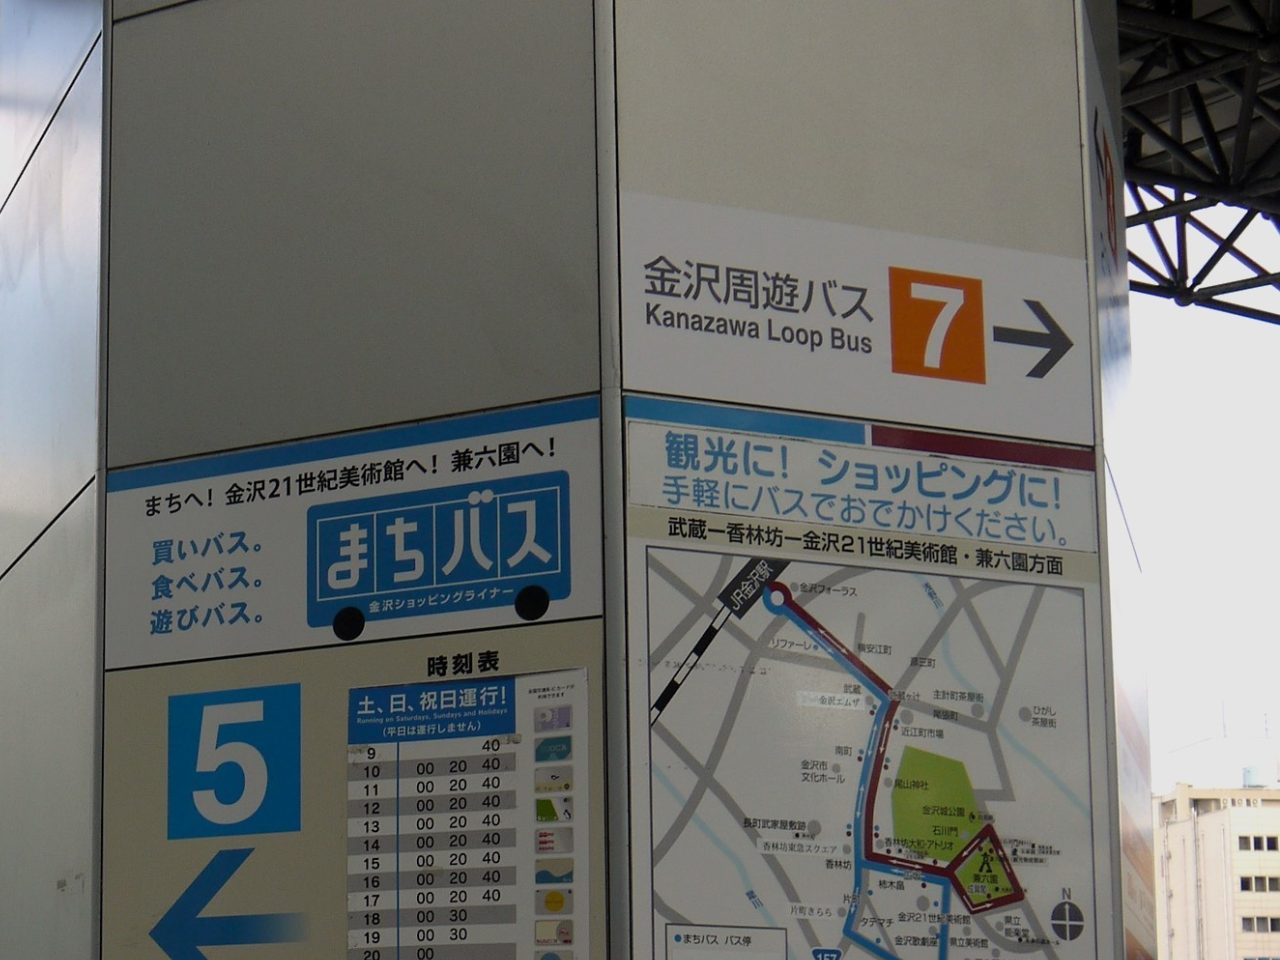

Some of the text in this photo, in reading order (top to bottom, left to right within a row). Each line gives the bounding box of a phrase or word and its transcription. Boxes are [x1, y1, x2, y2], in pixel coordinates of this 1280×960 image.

[644, 256, 874, 322] 金沢周遊バス
[645, 302, 873, 354] Kanazawa Loop Bus
[910, 282, 965, 368] 7
[662, 476, 1067, 547] 手軽にバスでおでかけください。
[152, 530, 263, 566] 買いバス。
[327, 488, 553, 591] まちバス
[151, 565, 263, 600] 食べバス。
[730, 559, 774, 611] JR金沢駅
[800, 581, 858, 598] 金沢フォーラス
[368, 586, 515, 613] 金沢ショッピングライナー
[149, 602, 264, 635] 遊びバス。
[771, 638, 812, 651] リファーレ
[427, 650, 500, 677] 時刻表
[933, 689, 985, 704] 主計町茶屋街
[356, 715, 384, 725] Running
[433, 710, 461, 721] Sundays
[463, 709, 476, 717] and
[478, 707, 508, 717] Holidays
[1033, 705, 1057, 717] ひがし
[1032, 717, 1057, 729] 茶屋街
[901, 727, 945, 739] 近江町市場
[367, 739, 501, 760] 9 40
[835, 746, 853, 757] 南町
[191, 699, 269, 825] 5
[363, 758, 501, 779] 10 00 20 40
[801, 760, 829, 771] 金沢市
[363, 776, 501, 797] 11 00 20 40
[801, 772, 846, 785] 文化ホール
[894, 779, 929, 791] 尾山神社
[363, 795, 501, 815] 12 00 20 40
[922, 805, 966, 818] 金沢城公園
[363, 814, 501, 833] 13 00 20 40
[743, 817, 807, 832] 長町武家屋敷跡
[932, 825, 959, 837] 石川門
[363, 833, 501, 852] 14 00 20 40
[363, 851, 501, 870] 15 00 20 40
[825, 859, 852, 871] 香林坊
[363, 870, 501, 889] 16 00 20 40
[363, 889, 501, 907] 17 00 20 40
[1061, 888, 1072, 900] N
[363, 909, 467, 926] 18 00 30
[790, 905, 833, 918] 片町きらら
[898, 911, 973, 927] 金沢21世紀美術館
[860, 917, 894, 929] タテマチ
[363, 928, 467, 944] 19 00 30
[683, 933, 753, 947] まちバス バス停
[895, 935, 940, 948] 金沢歌劇座
[949, 936, 990, 949] 県立美術館
[416, 948, 434, 960] 00
